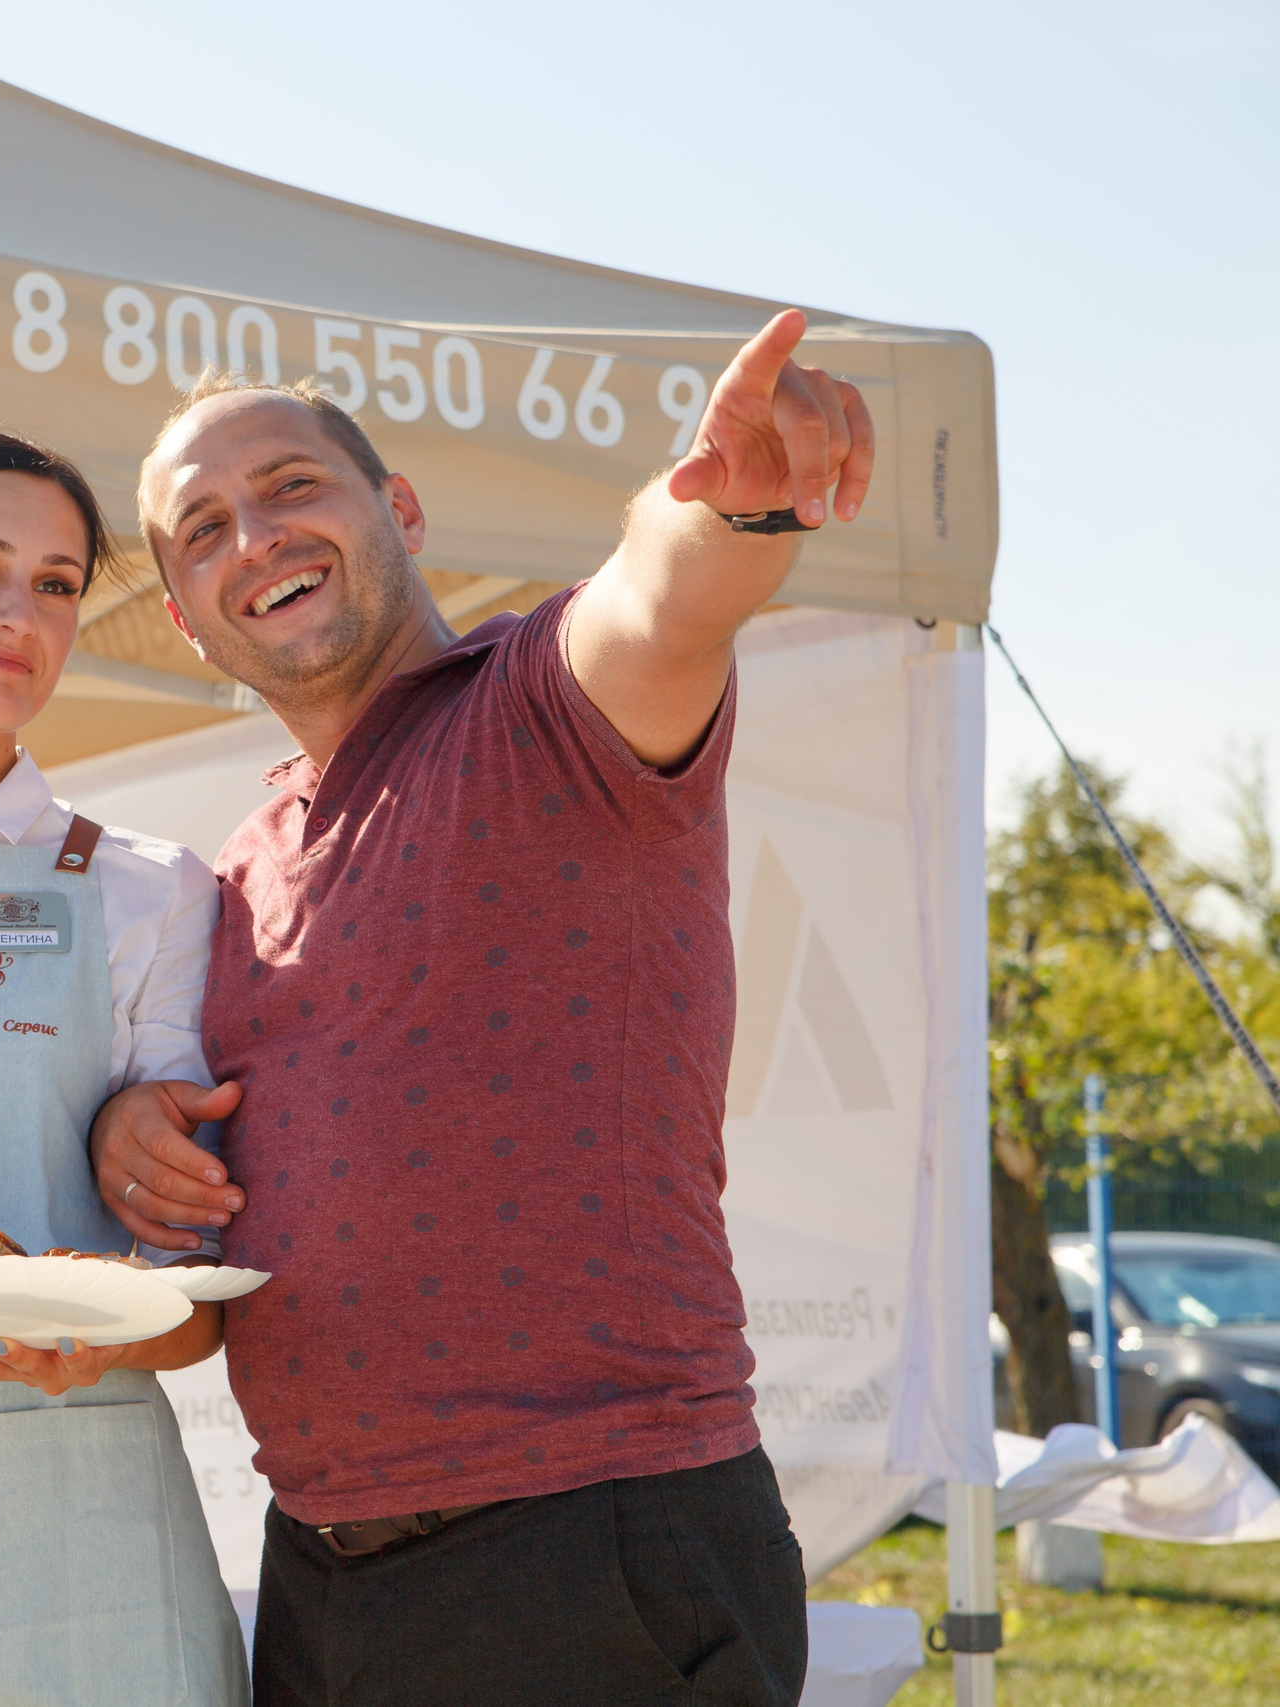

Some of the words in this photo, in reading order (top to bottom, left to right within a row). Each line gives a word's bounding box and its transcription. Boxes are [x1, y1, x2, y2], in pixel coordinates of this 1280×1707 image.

[11, 271, 69, 373] 8
[101, 285, 281, 391] 800
[314, 316, 486, 431] 550
[516, 348, 626, 448] 66
[3, 1018, 59, 1037] Сервис
